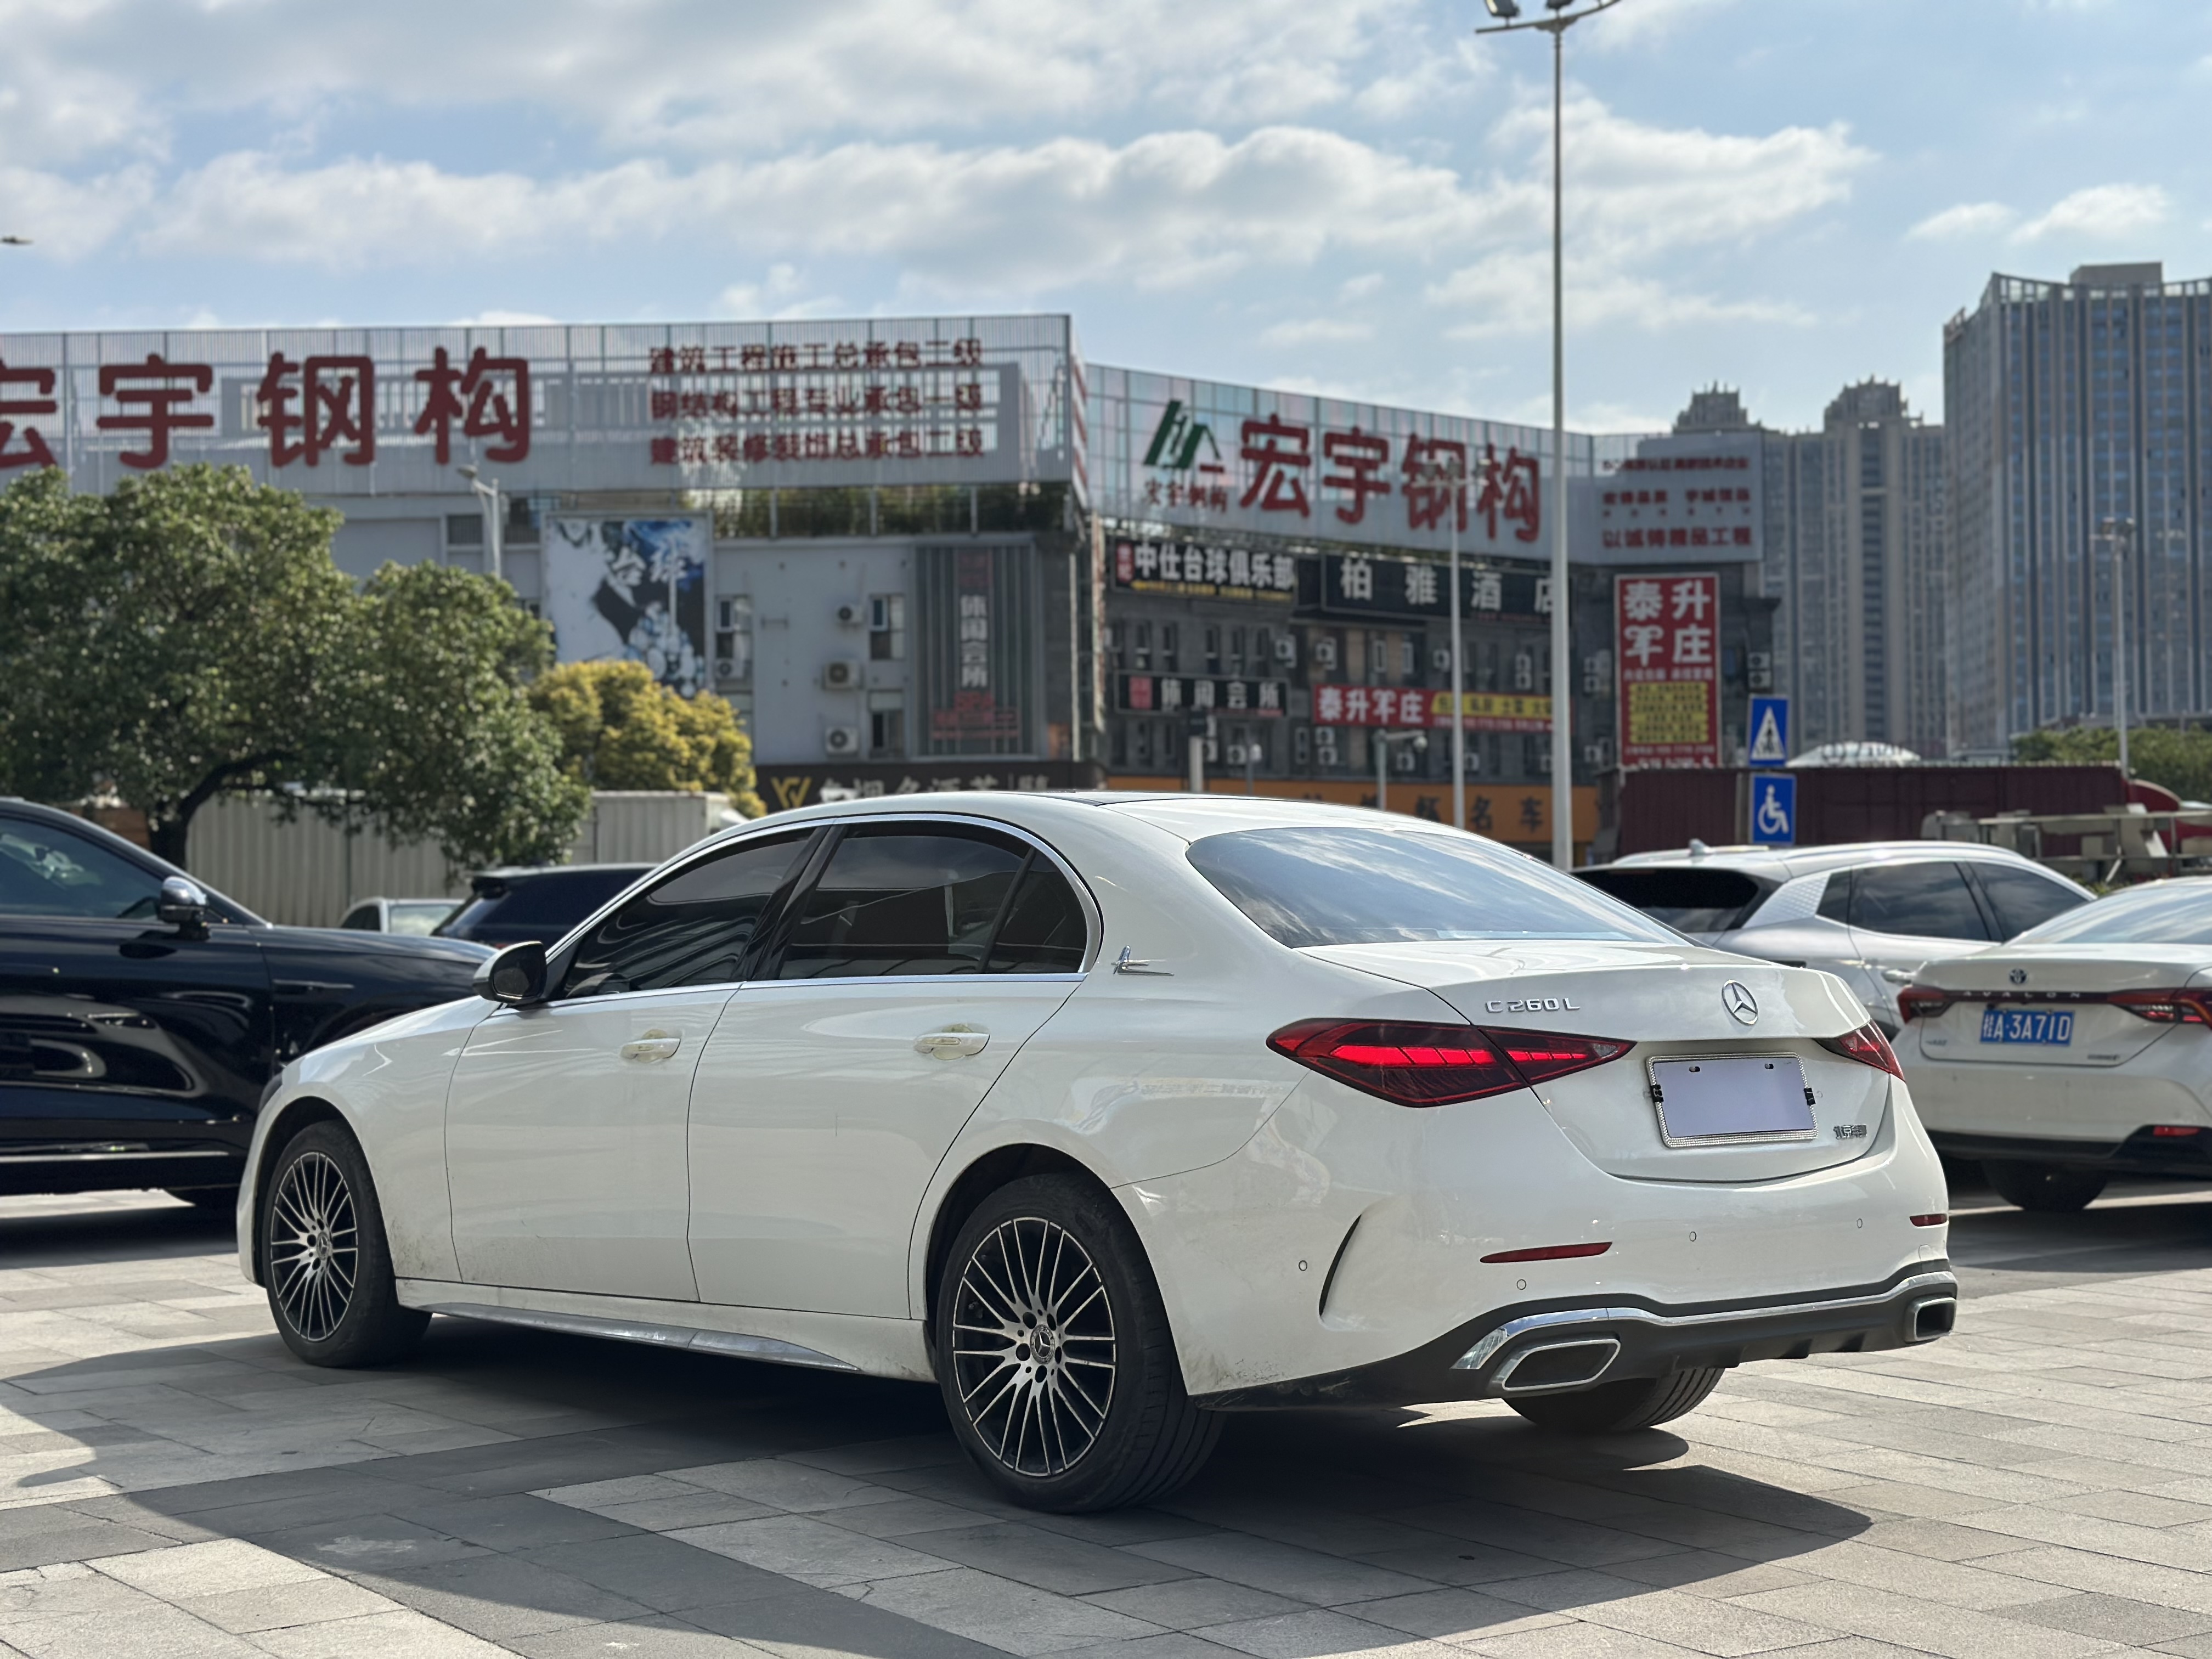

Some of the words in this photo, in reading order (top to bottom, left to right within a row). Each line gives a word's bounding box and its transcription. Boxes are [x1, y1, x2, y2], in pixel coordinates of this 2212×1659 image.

[1239, 414, 1541, 543] 宏宇钢构
[1623, 579, 1712, 621] 泰升
[1623, 623, 1713, 667] 羊庄
[954, 691, 995, 712] SPA
[1318, 686, 1424, 725] 泰升羊庄
[1485, 1000, 1503, 1013] C
[1507, 998, 1560, 1013] 260
[1562, 997, 1581, 1011] L
